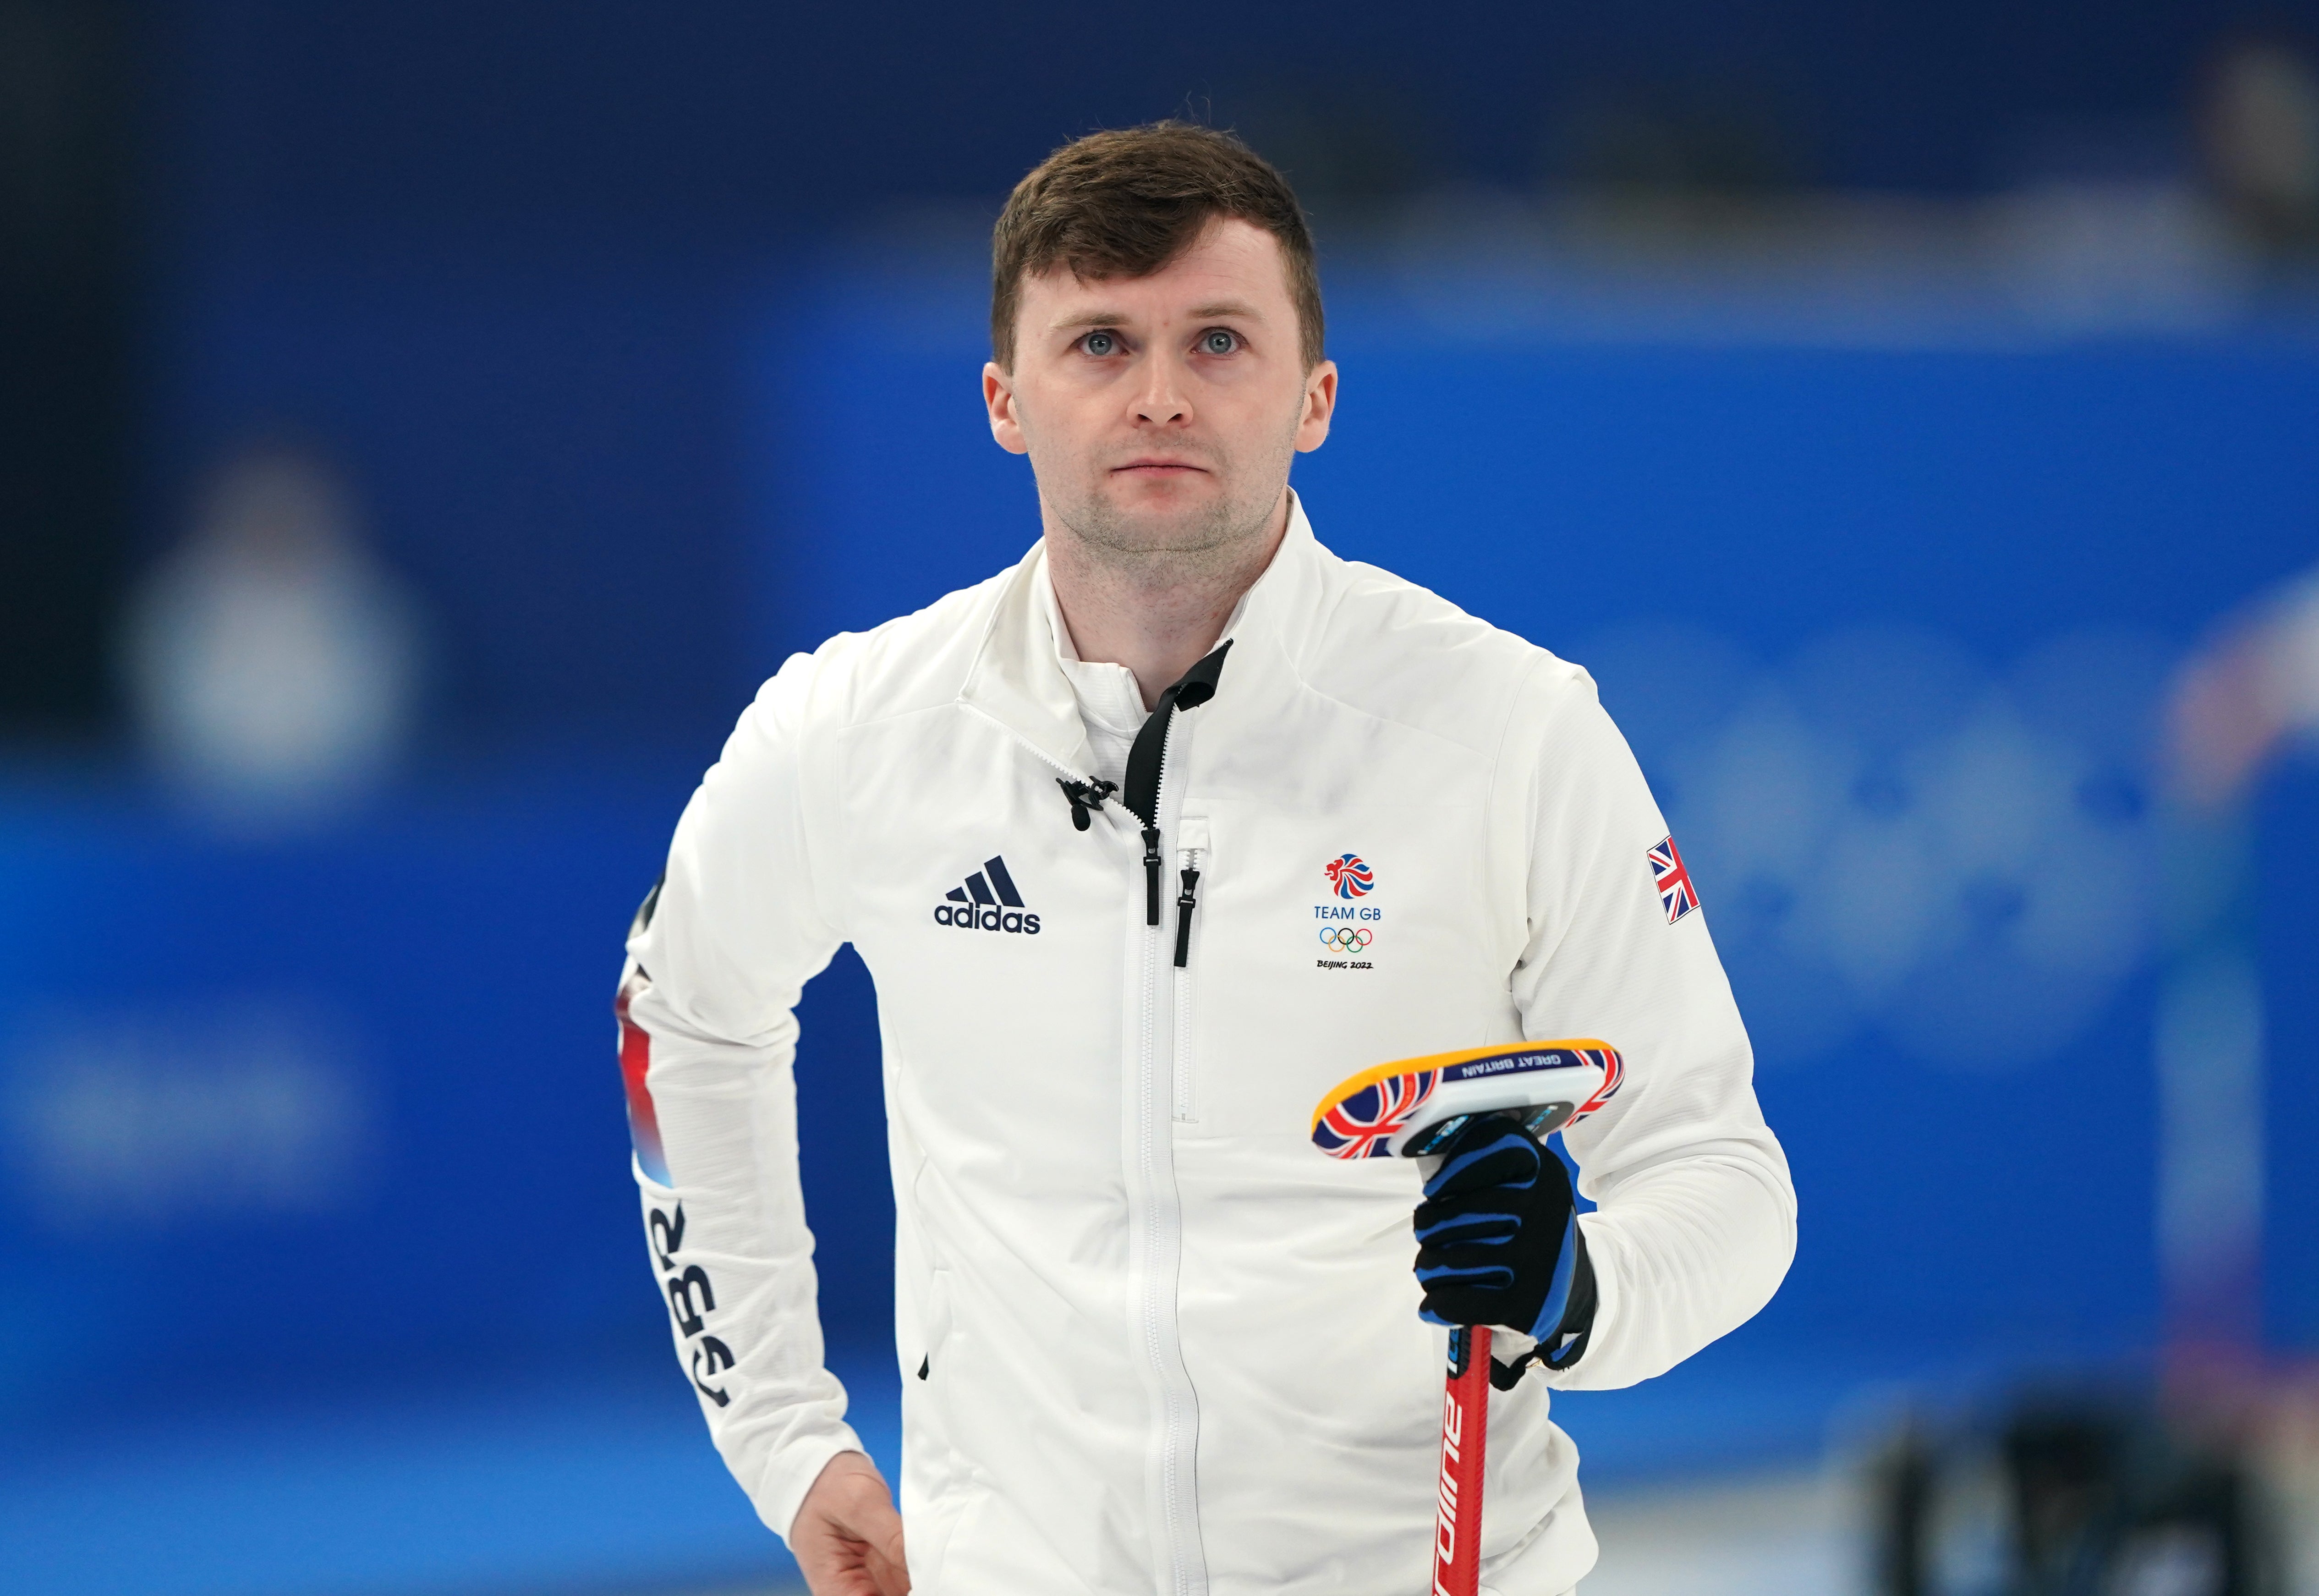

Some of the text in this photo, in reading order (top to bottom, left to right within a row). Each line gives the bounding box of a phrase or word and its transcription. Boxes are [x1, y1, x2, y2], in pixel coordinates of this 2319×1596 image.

[934, 902, 1040, 934] adidas
[1314, 906, 1381, 920] TEAM GB
[1317, 960, 1347, 970] BEIJING
[1462, 1054, 1562, 1078] GREAT BRITAIN
[650, 1198, 735, 1407] GBR
